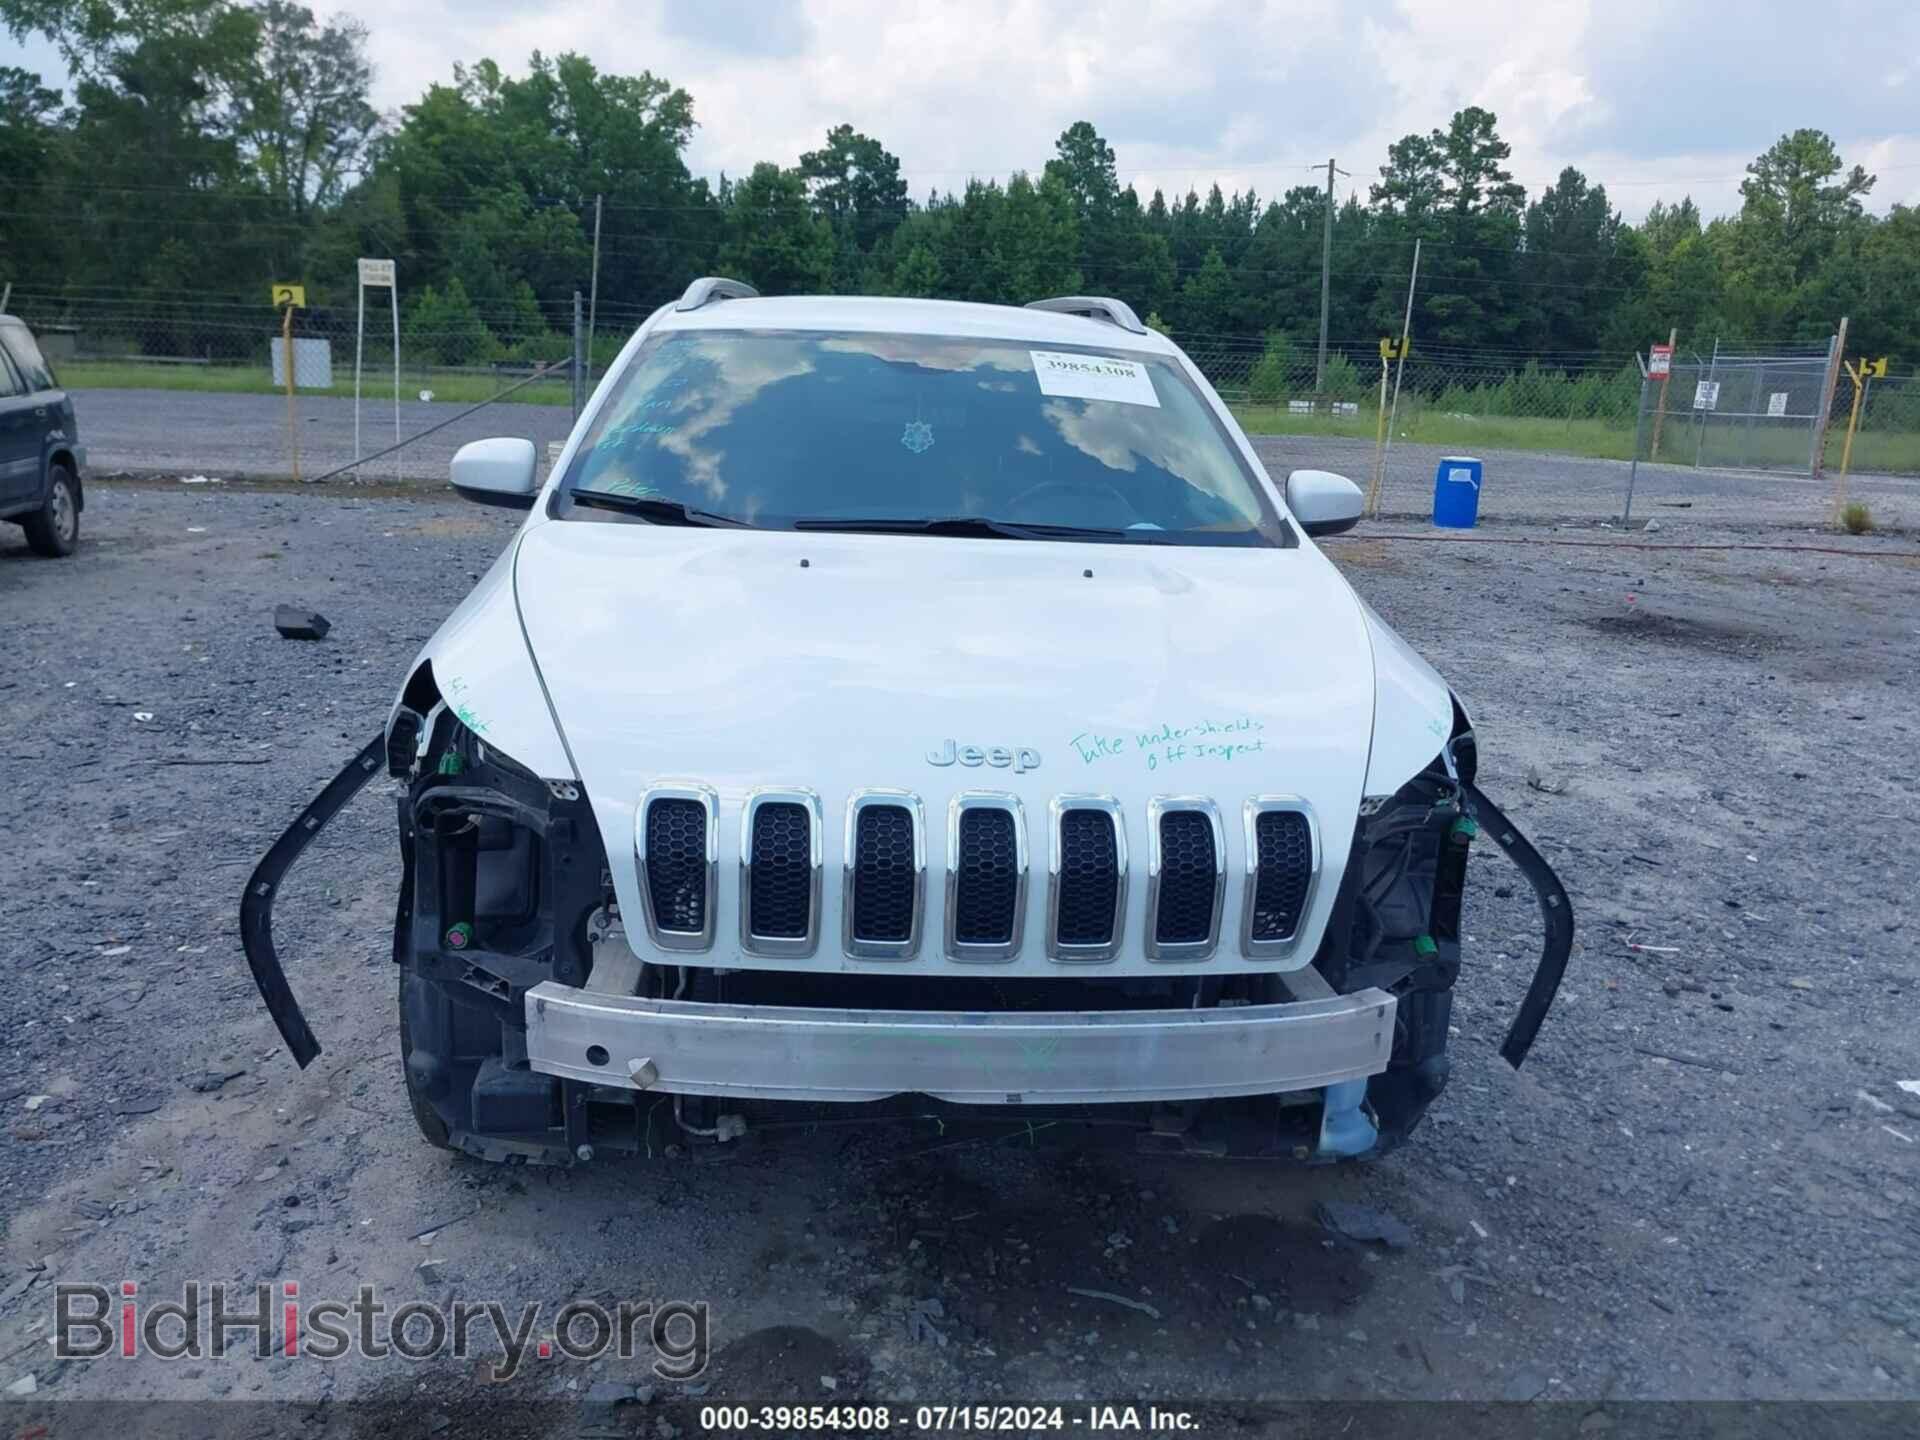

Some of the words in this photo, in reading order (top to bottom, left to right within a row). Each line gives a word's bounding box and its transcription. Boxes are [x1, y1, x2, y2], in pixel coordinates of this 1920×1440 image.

[279, 288, 298, 306] 2
[1048, 360, 1136, 378] 39854308
[1865, 357, 1878, 377] 5
[926, 739, 1041, 774] Jeep
